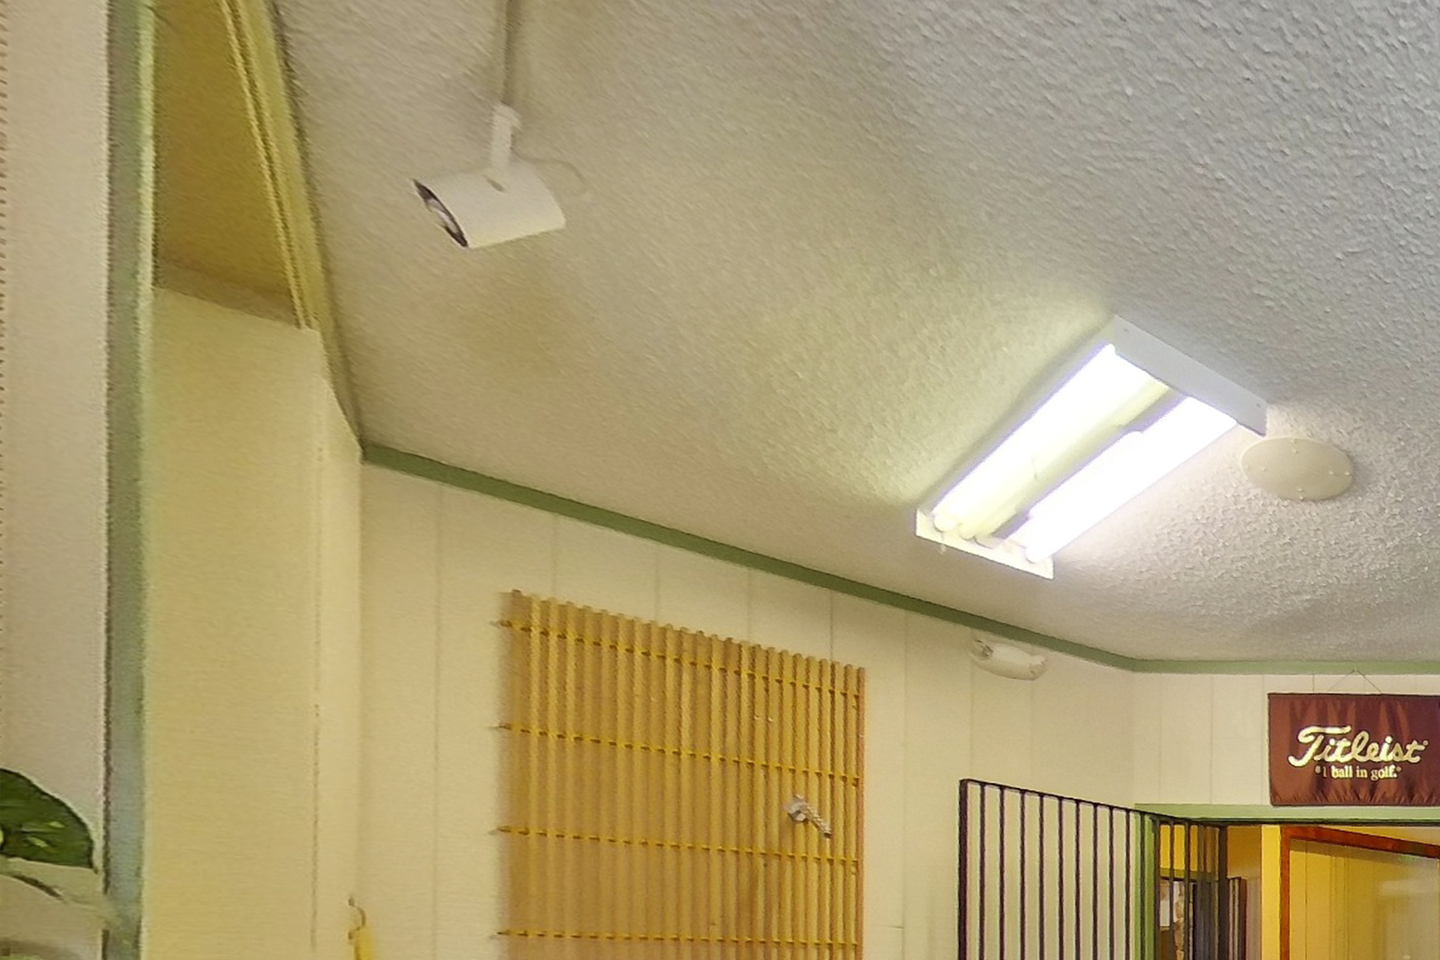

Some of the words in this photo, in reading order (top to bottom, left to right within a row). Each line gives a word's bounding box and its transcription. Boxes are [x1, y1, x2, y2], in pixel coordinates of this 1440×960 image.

[1287, 725, 1426, 767] Titleist
[1331, 765, 1353, 778] ball
[1356, 766, 1368, 778] in
